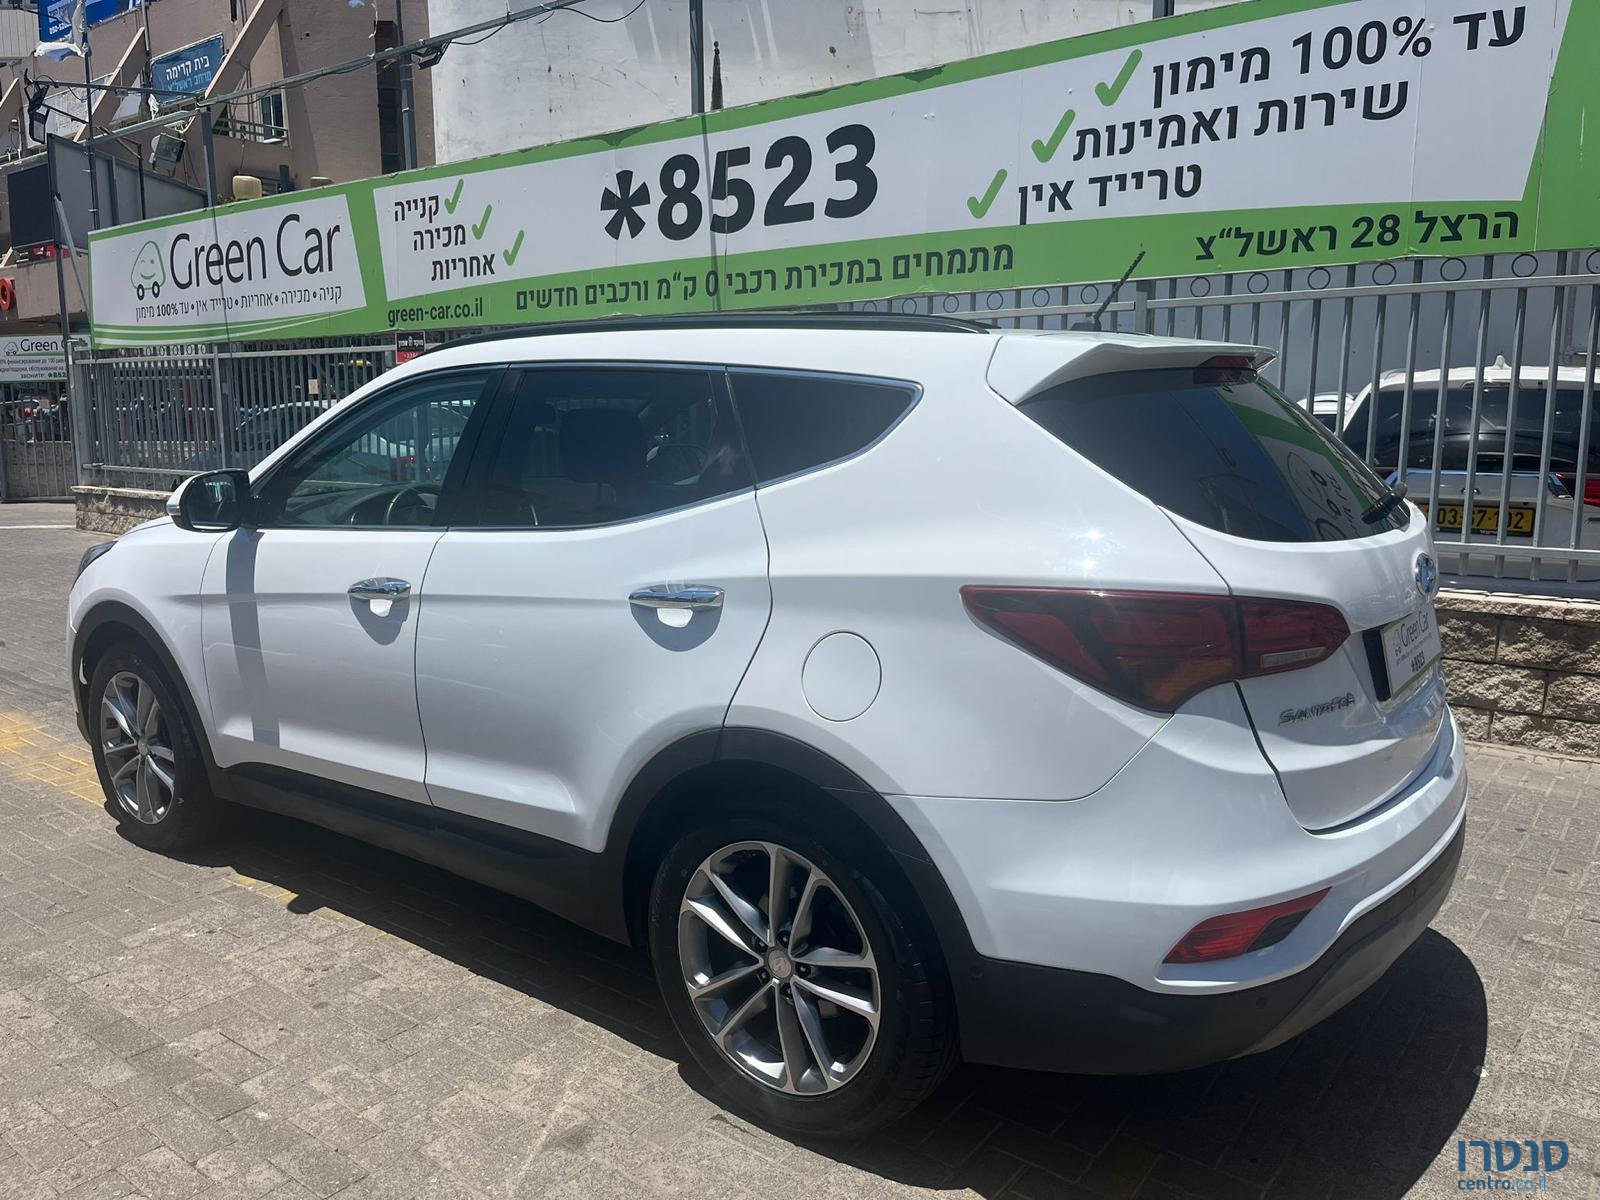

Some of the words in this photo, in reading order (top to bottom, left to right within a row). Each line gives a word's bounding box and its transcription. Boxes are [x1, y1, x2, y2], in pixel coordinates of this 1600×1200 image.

[1452, 6, 1527, 51] עד
[1293, 15, 1432, 75] 100%
[166, 61, 192, 81] קדימה
[194, 56, 210, 71] בית
[1152, 45, 1271, 109] מימון
[1253, 80, 1410, 137] שירות
[1072, 104, 1239, 162] ואמינות
[1088, 163, 1202, 207] טרייד
[393, 194, 440, 224] קנייה
[1018, 179, 1075, 226] אין
[413, 223, 467, 251] מכירה
[1350, 214, 1401, 249] 28
[1414, 210, 1519, 244] הרצל
[170, 232, 268, 290] Green
[276, 213, 341, 277] Car
[892, 243, 1014, 281] מתמחים
[431, 253, 496, 281] אחריות
[784, 257, 883, 291] במכירת
[281, 288, 311, 305] מכירה
[319, 285, 342, 304] קניה
[585, 279, 649, 305] ורכבים
[657, 271, 697, 301] ק"מ
[705, 269, 720, 297] 0
[726, 269, 777, 295] רכבי
[157, 303, 179, 317] 100%
[210, 296, 234, 311] טרייד
[241, 292, 274, 309] אחריות
[388, 296, 483, 328] green-car.co.il
[516, 286, 578, 311] חדשים
[135, 305, 155, 323] מימון
[20, 338, 59, 352] Green
